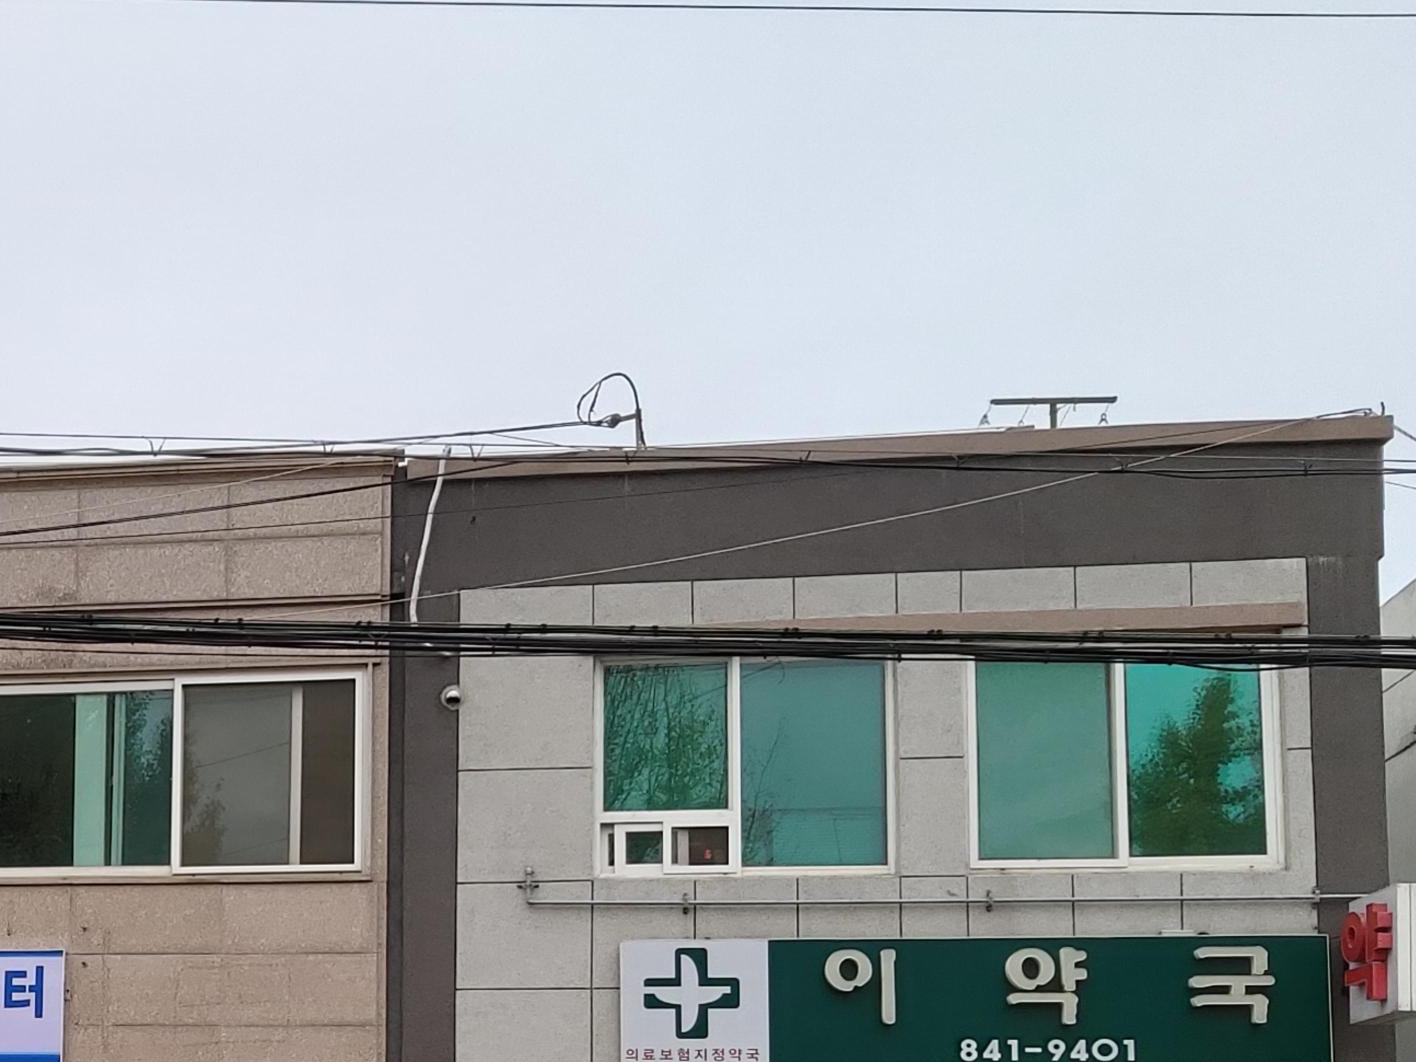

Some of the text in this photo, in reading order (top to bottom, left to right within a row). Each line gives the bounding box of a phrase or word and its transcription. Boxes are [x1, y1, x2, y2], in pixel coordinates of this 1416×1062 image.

[1340, 903, 1393, 1001] 약
[625, 1048, 760, 1062] 의료보험지정약국
[958, 1038, 1138, 1062] 841-9401
